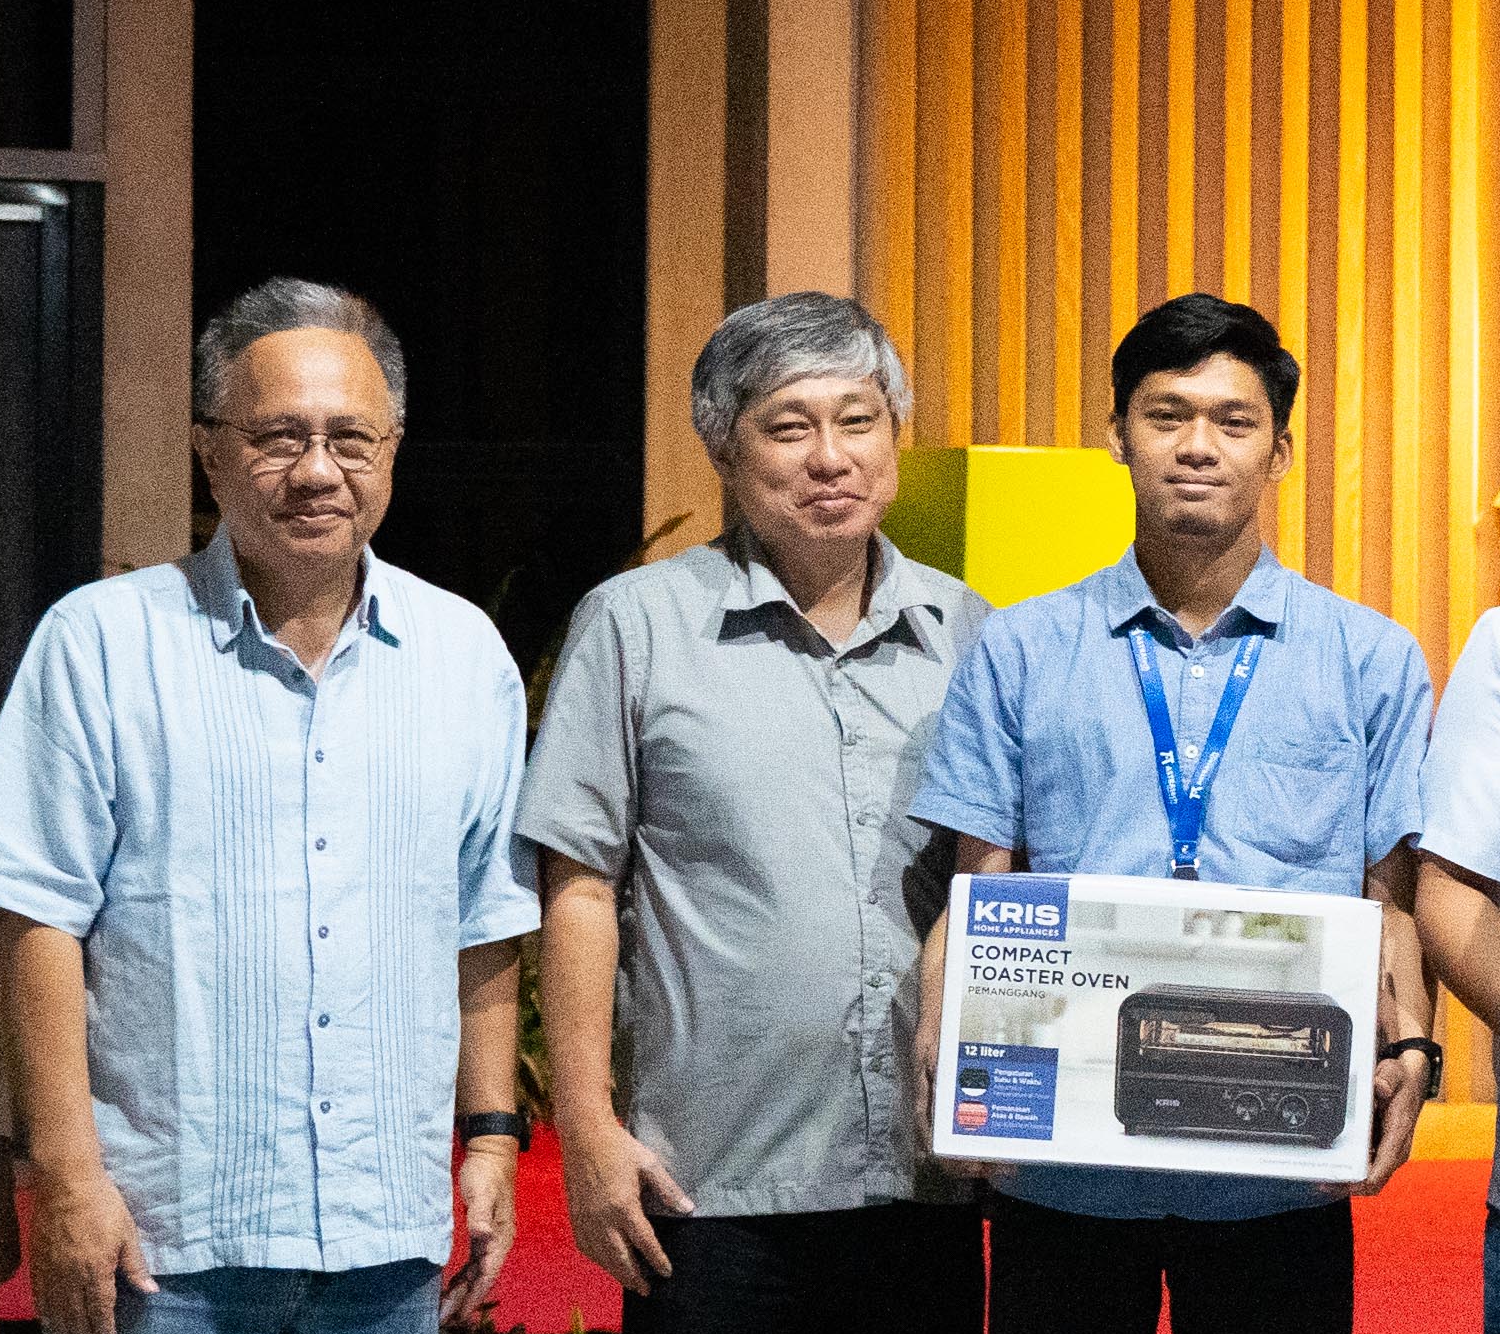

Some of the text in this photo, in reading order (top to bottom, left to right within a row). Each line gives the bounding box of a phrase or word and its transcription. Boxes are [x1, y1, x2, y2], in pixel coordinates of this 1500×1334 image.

[974, 900, 1060, 927] KRIS
[973, 924, 1059, 937] HOME APPLIANCES
[971, 944, 1072, 965] COMPACT
[969, 965, 1130, 990] TOASTER OVEN
[967, 985, 1046, 999] PEMANGGANG
[964, 1045, 1006, 1058] 12 liter
